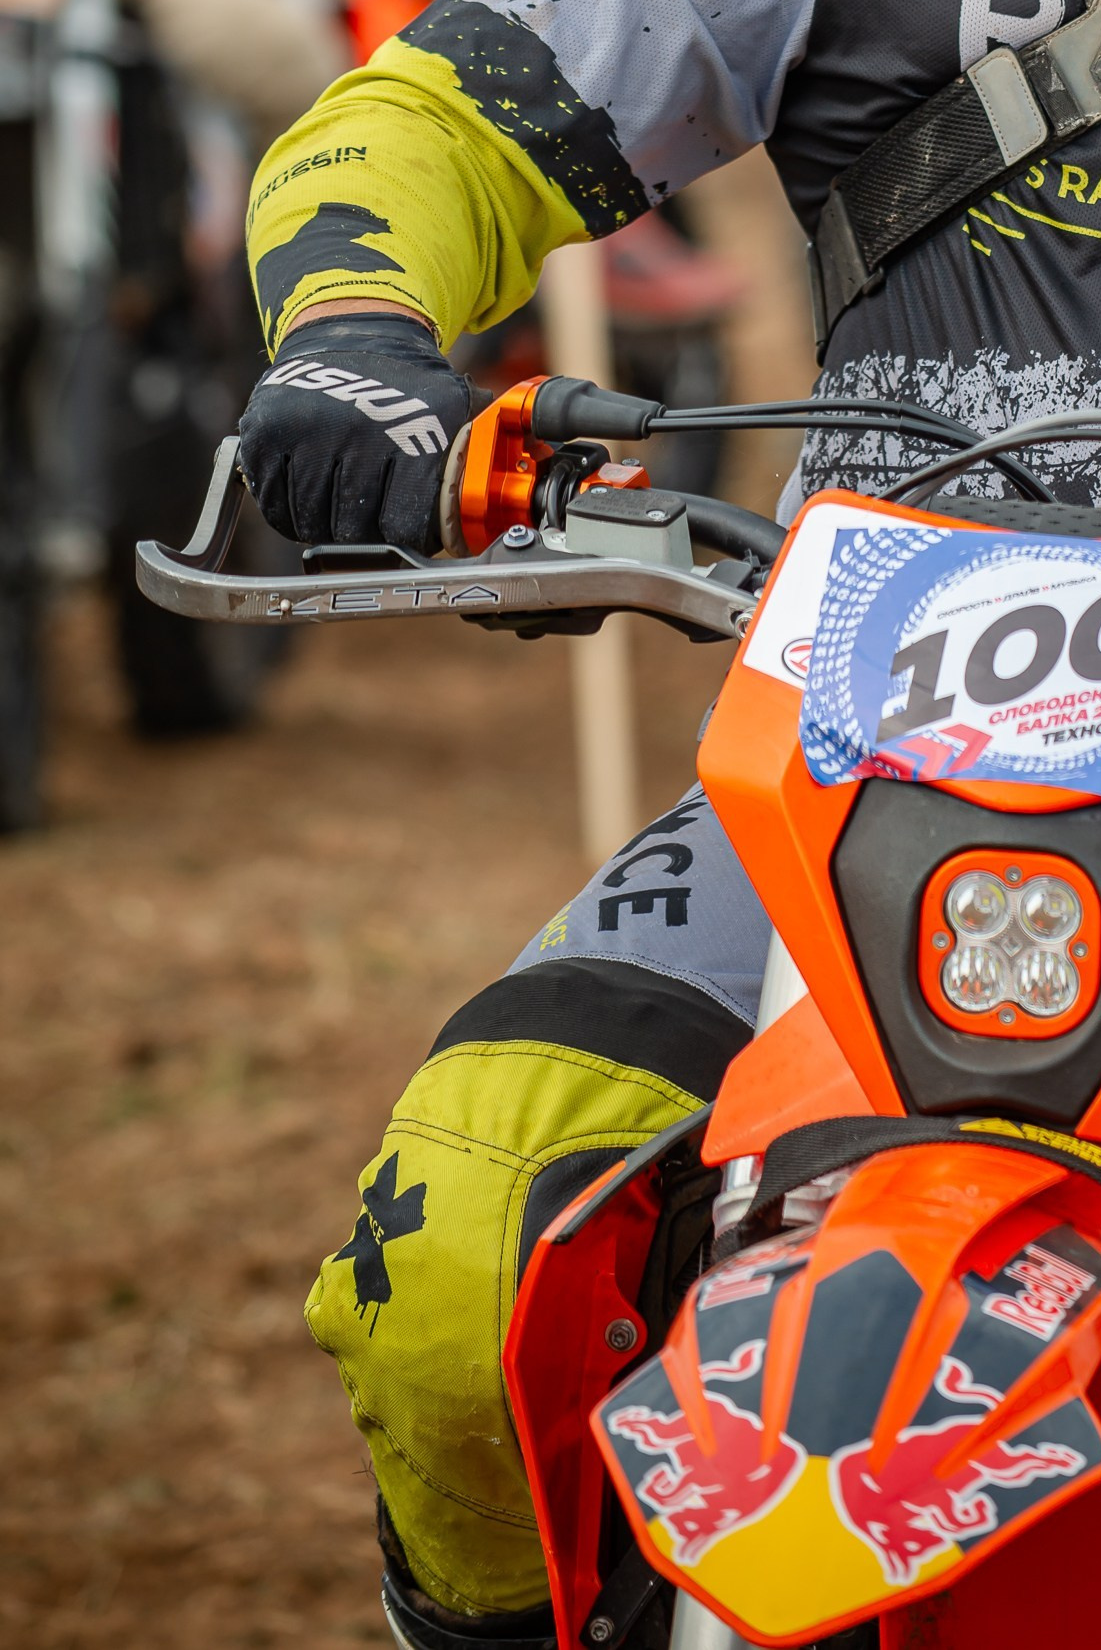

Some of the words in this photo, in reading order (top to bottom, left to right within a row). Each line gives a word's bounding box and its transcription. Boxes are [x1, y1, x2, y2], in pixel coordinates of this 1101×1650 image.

[262, 360, 449, 457] USWE
[267, 583, 502, 618] ZETA
[1016, 709, 1089, 736] БАЛКА
